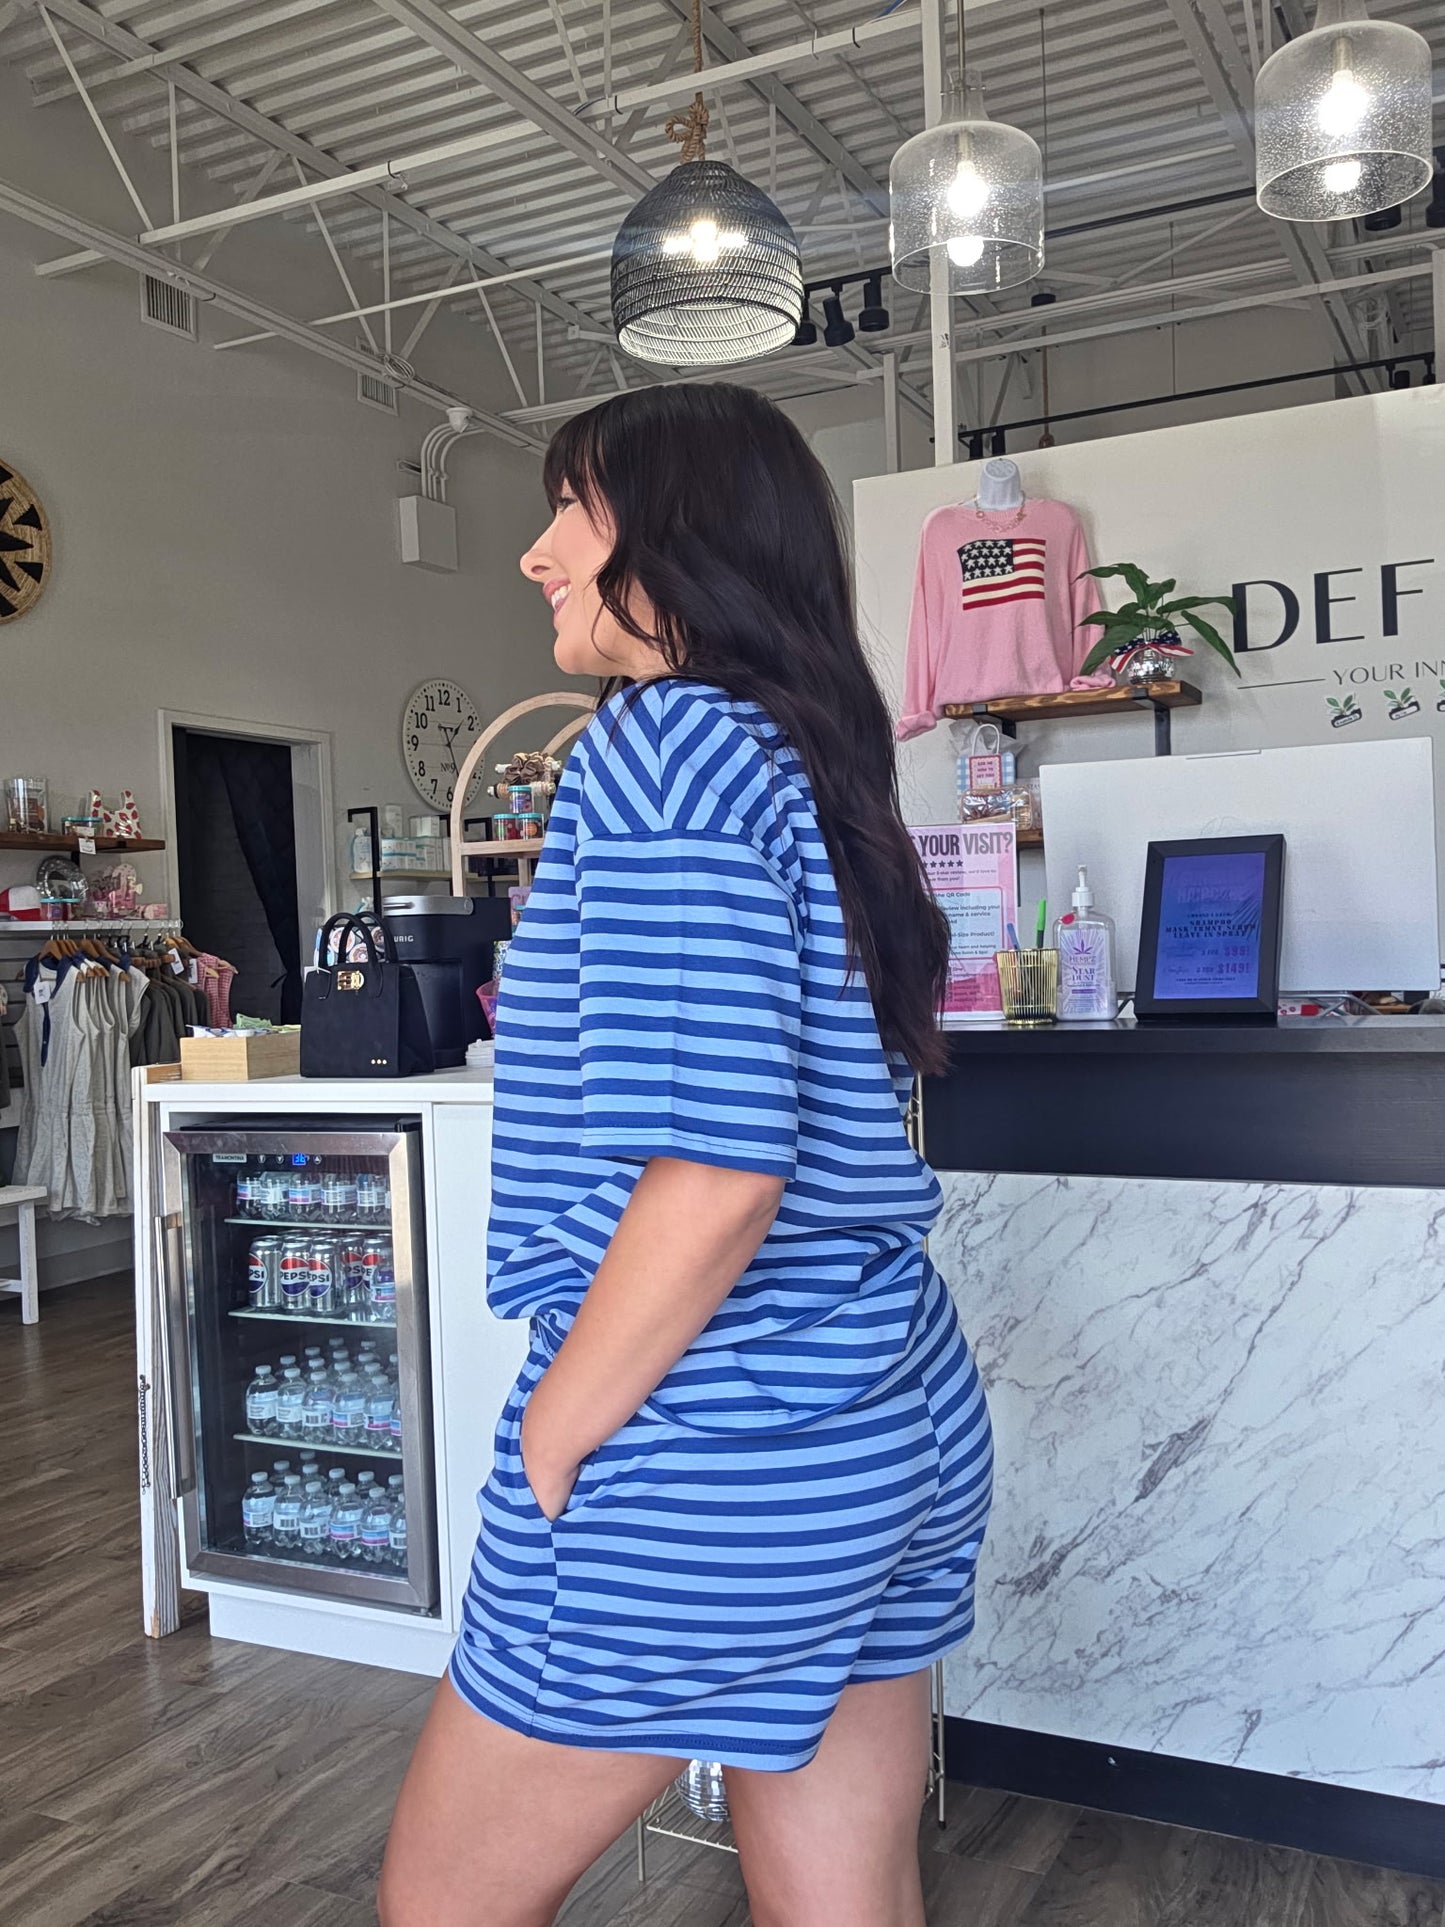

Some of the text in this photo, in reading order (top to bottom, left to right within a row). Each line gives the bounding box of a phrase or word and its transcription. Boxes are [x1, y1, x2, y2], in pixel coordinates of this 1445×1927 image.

[1333, 660, 1445, 685] YOUR IN
[425, 695, 435, 712] 11
[438, 688, 450, 706] 12
[456, 697, 462, 713] 1
[415, 712, 428, 729] 10
[467, 715, 475, 731] 2
[411, 735, 419, 751] 9
[418, 760, 426, 776] 8
[431, 778, 438, 794] 7
[446, 786, 454, 801] 6
[919, 831, 1013, 857] YOUR VISIT?
[249, 1269, 264, 1277] PSI
